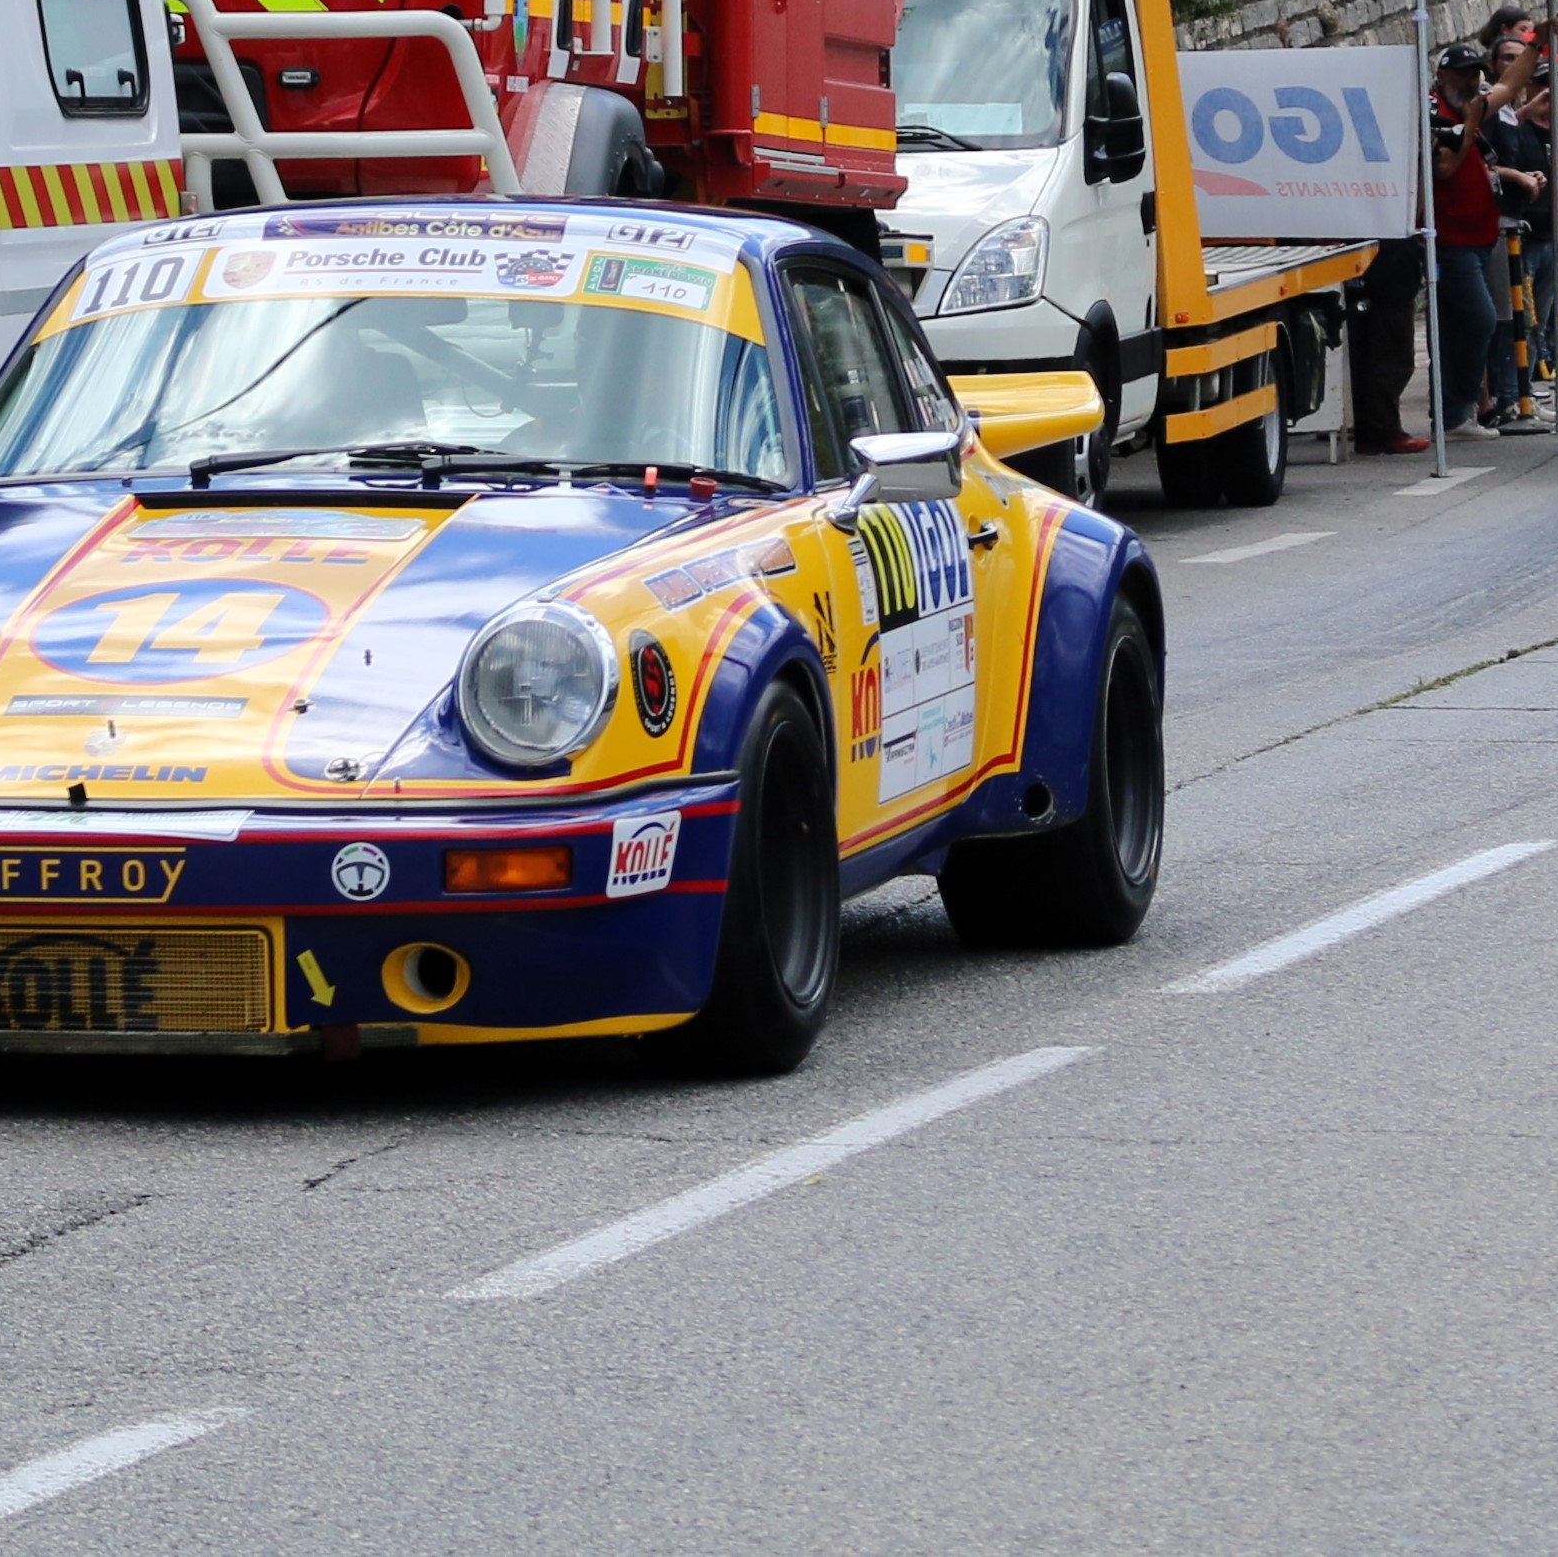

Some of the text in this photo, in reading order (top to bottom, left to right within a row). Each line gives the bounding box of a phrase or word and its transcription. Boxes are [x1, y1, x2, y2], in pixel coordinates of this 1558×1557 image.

[335, 220, 563, 240] Antibes Côte d'Azur
[285, 247, 487, 268] Porsche Club
[83, 256, 185, 316] 110
[300, 276, 459, 287] RS de France
[642, 282, 687, 300] 110
[898, 499, 969, 612] IGOL
[85, 592, 288, 665] 14
[11, 699, 242, 710] SPORT LEGENDS
[612, 820, 677, 887] KOLLÉ
